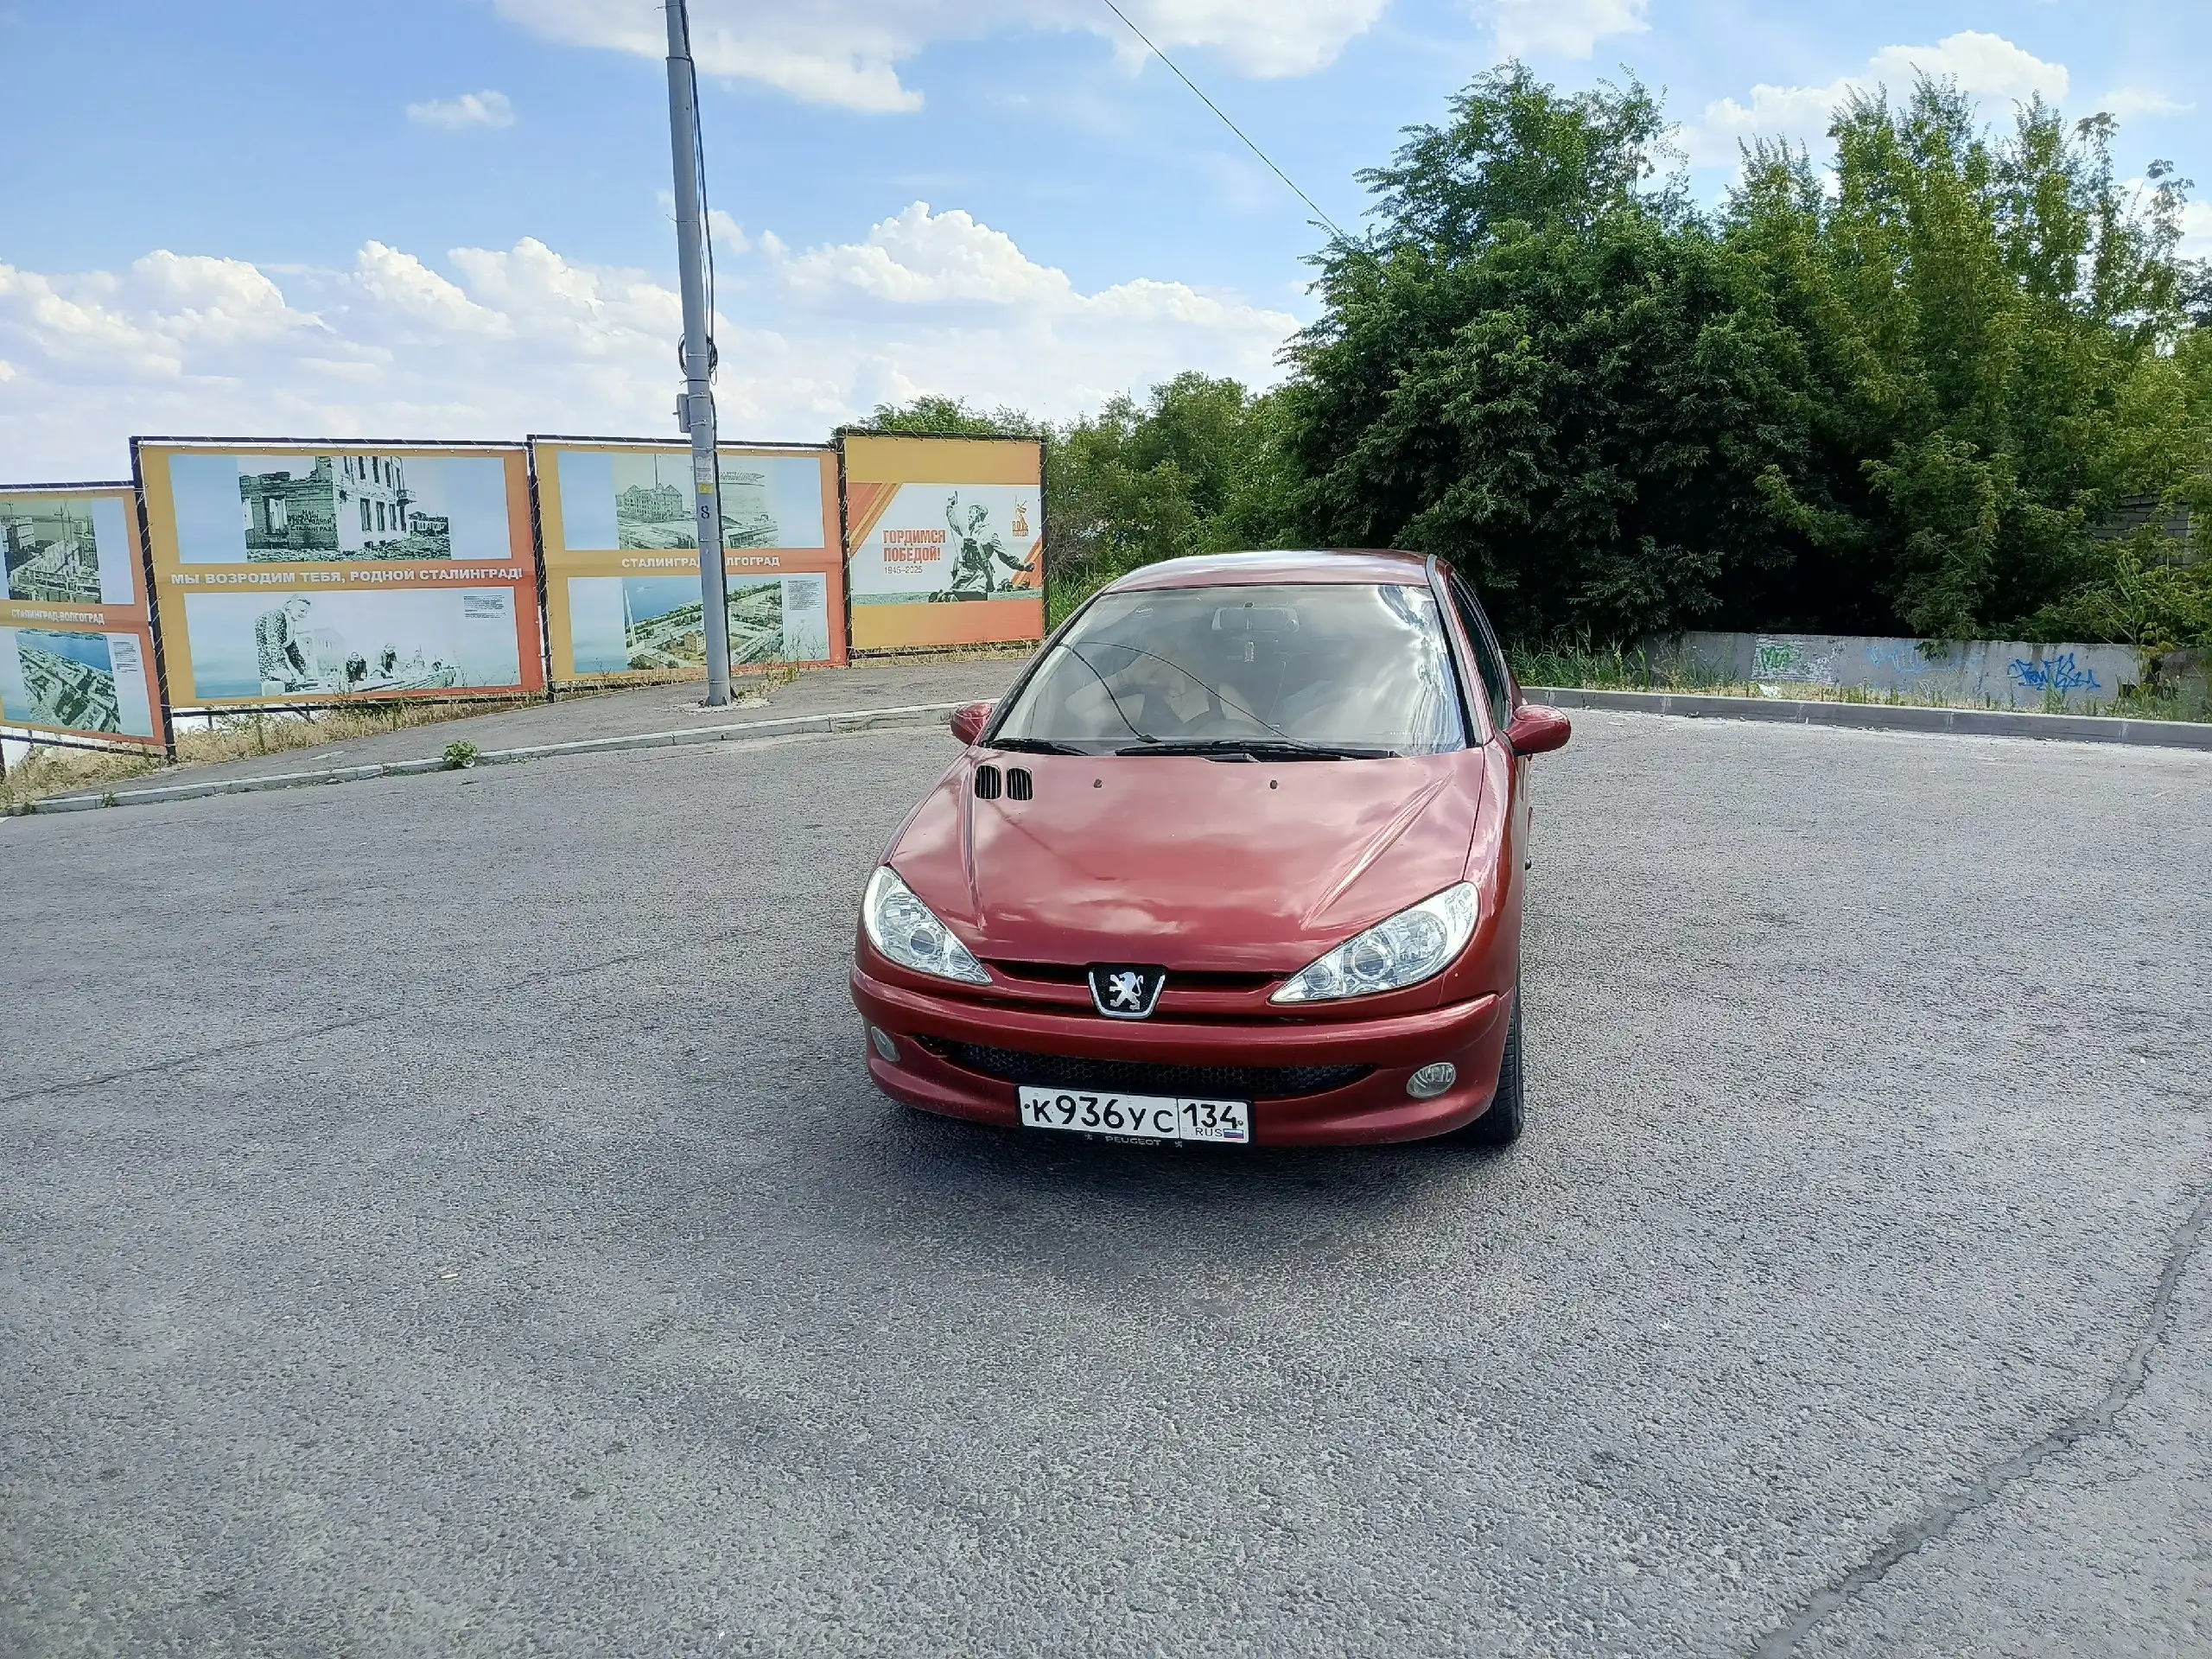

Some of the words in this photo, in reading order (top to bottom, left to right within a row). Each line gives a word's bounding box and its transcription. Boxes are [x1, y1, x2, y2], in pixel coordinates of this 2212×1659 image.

[882, 530, 946, 545] ГОРДИМСЯ
[883, 545, 940, 563] ПОБЕДОЙ!
[171, 574, 200, 584] МЫ
[205, 572, 296, 585] ВОЗРОДИМ
[300, 571, 346, 583] ТЕБЯ,
[350, 568, 415, 582] РОДНОЙ
[419, 567, 523, 581] СТАЛИНГРАД!
[11, 608, 105, 625] СТАЛИНГРАД-ВОЛГОГРАД
[1033, 1095, 1174, 1133] К936УС
[1182, 1103, 1237, 1128] 134
[1105, 1135, 1162, 1146] PEUGEOT
[1195, 1128, 1224, 1137] RUS
